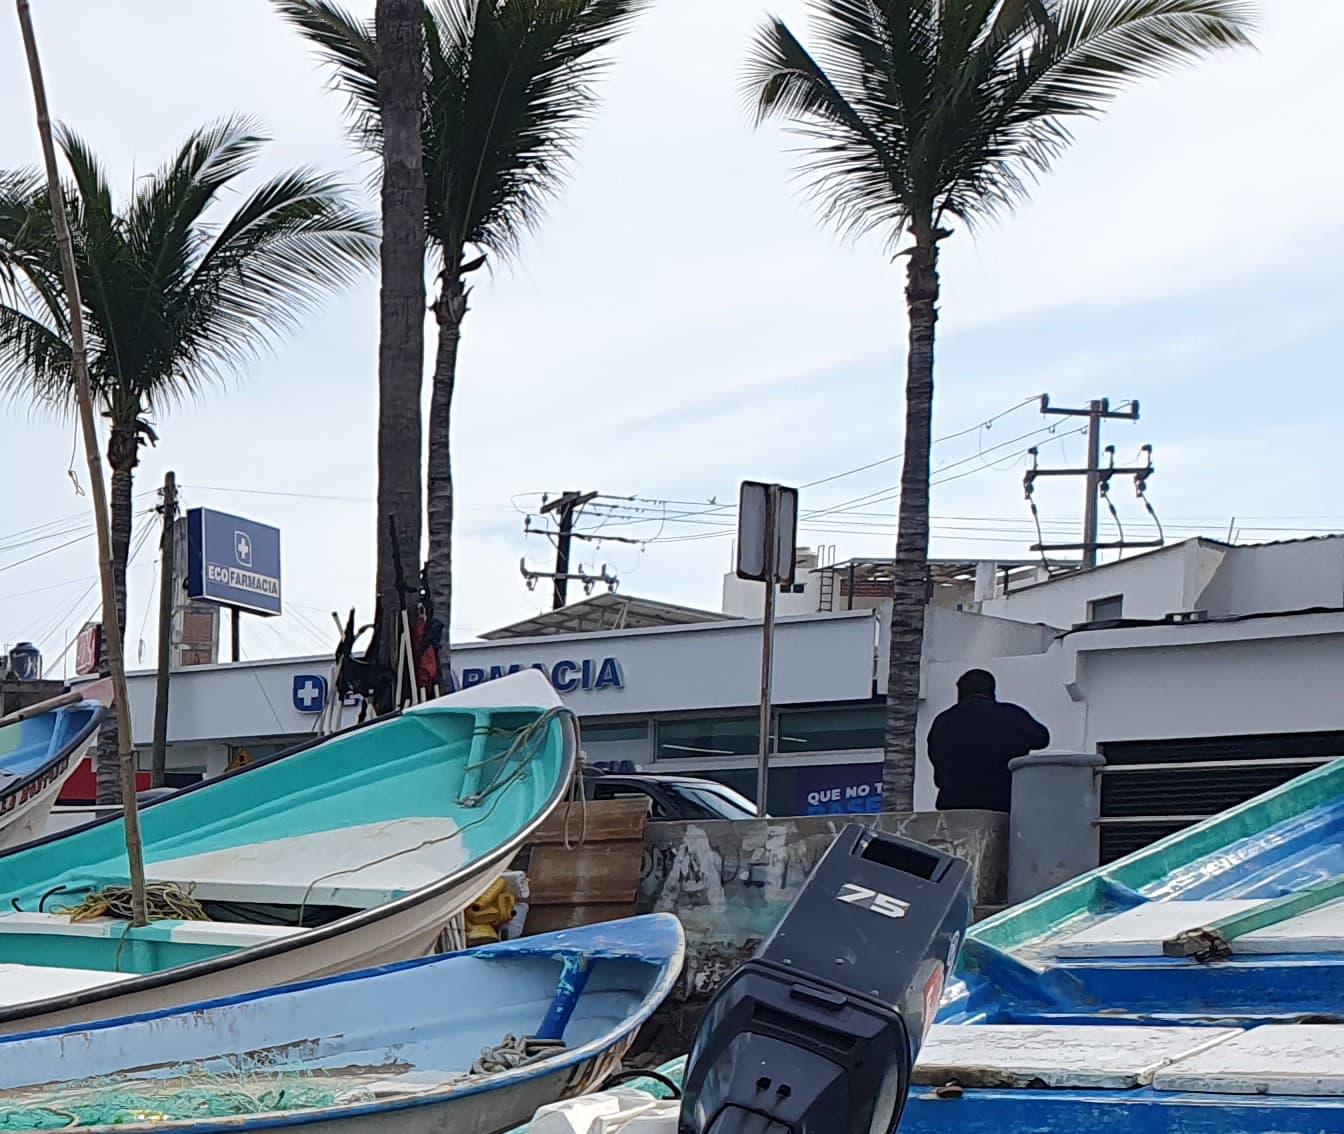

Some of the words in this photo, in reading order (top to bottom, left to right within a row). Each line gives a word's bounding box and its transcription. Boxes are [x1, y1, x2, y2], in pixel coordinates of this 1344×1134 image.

[808, 789, 841, 806] QUE
[845, 784, 870, 798] NO
[837, 883, 911, 918] 75
